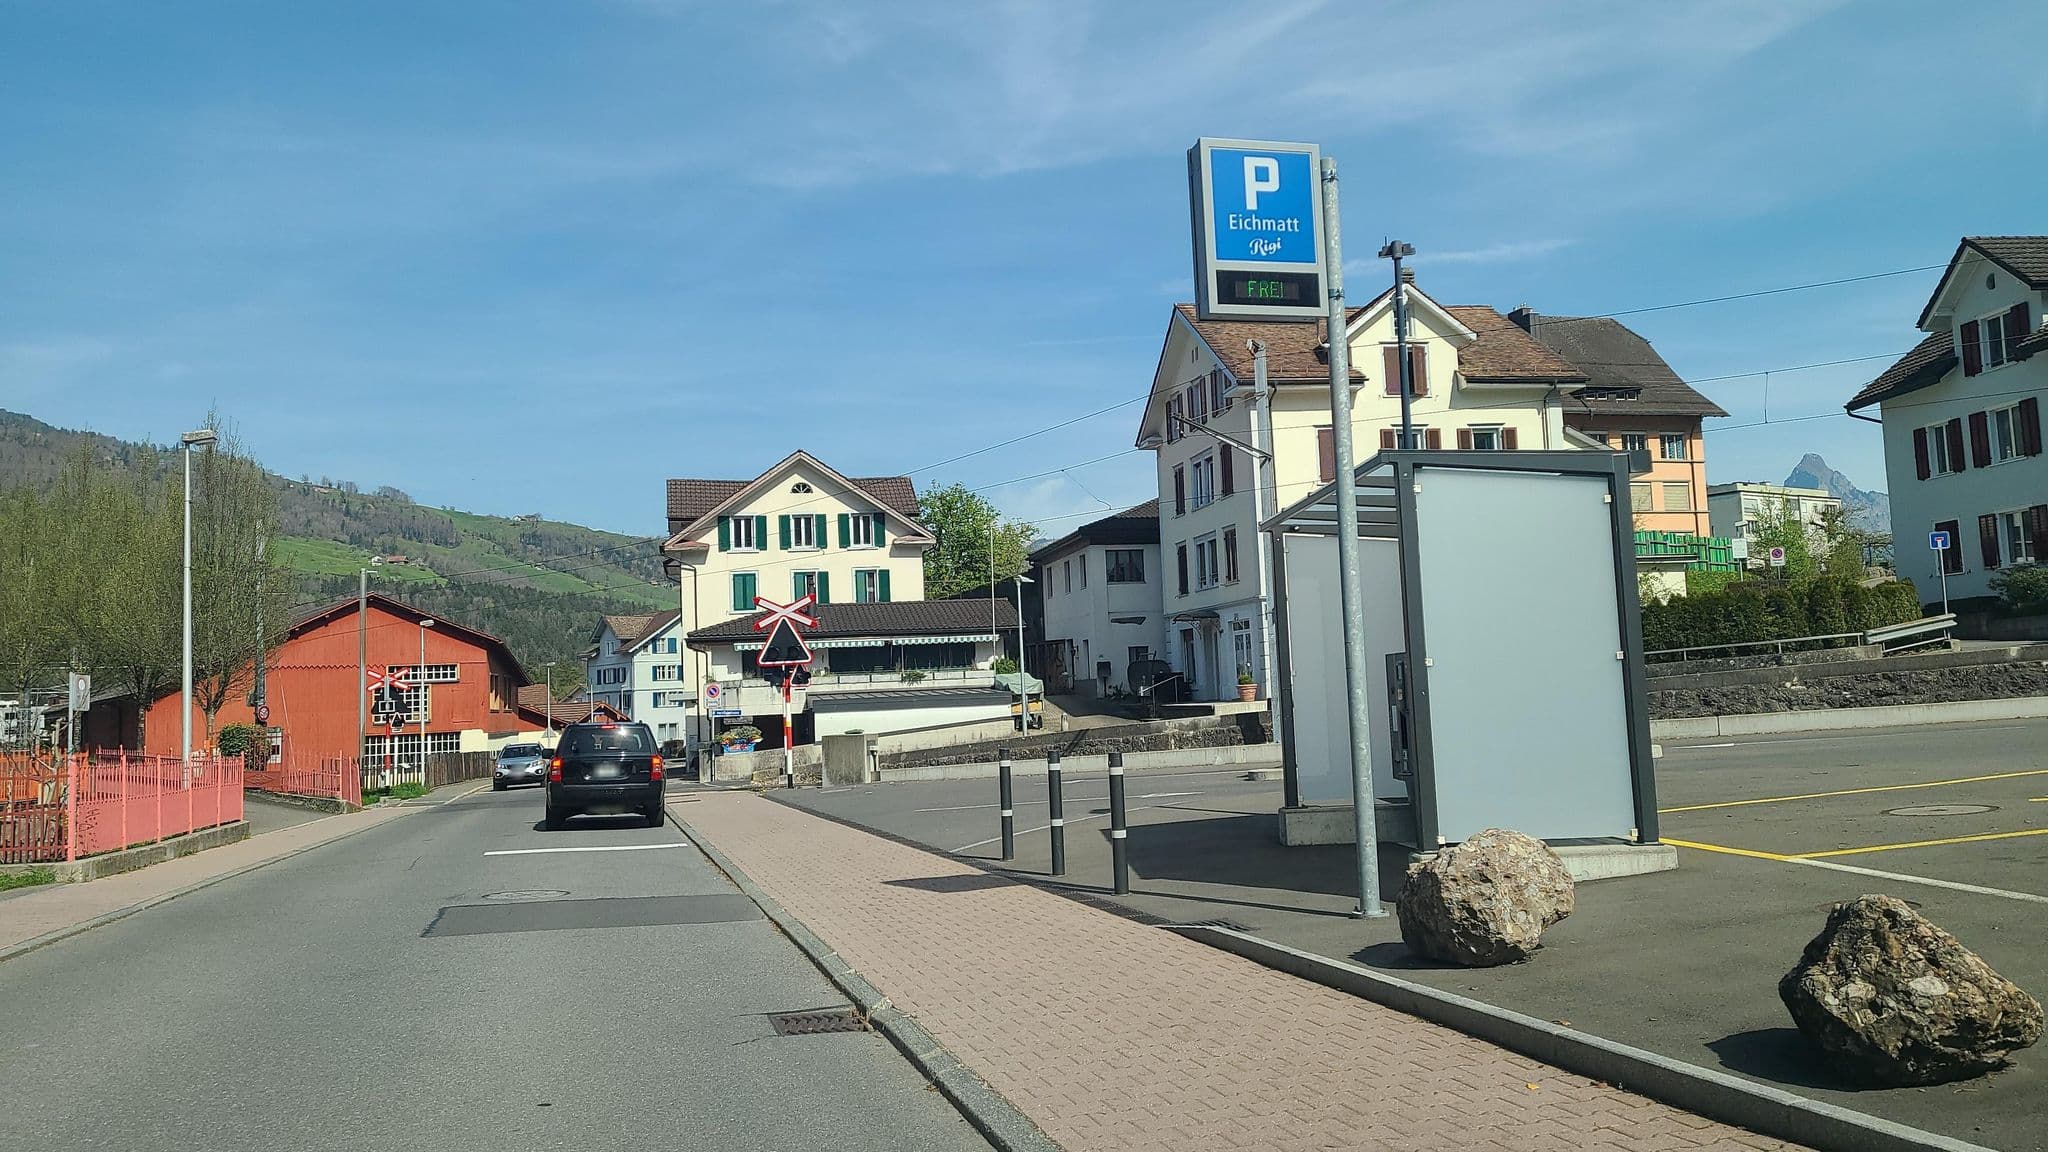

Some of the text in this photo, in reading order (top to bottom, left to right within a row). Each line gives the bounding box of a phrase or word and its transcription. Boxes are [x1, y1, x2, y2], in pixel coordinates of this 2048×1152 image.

[1243, 156, 1280, 211] P
[1229, 213, 1300, 233] Eichmatt
[1248, 237, 1282, 256] Rigi
[1247, 280, 1284, 298] FREI
